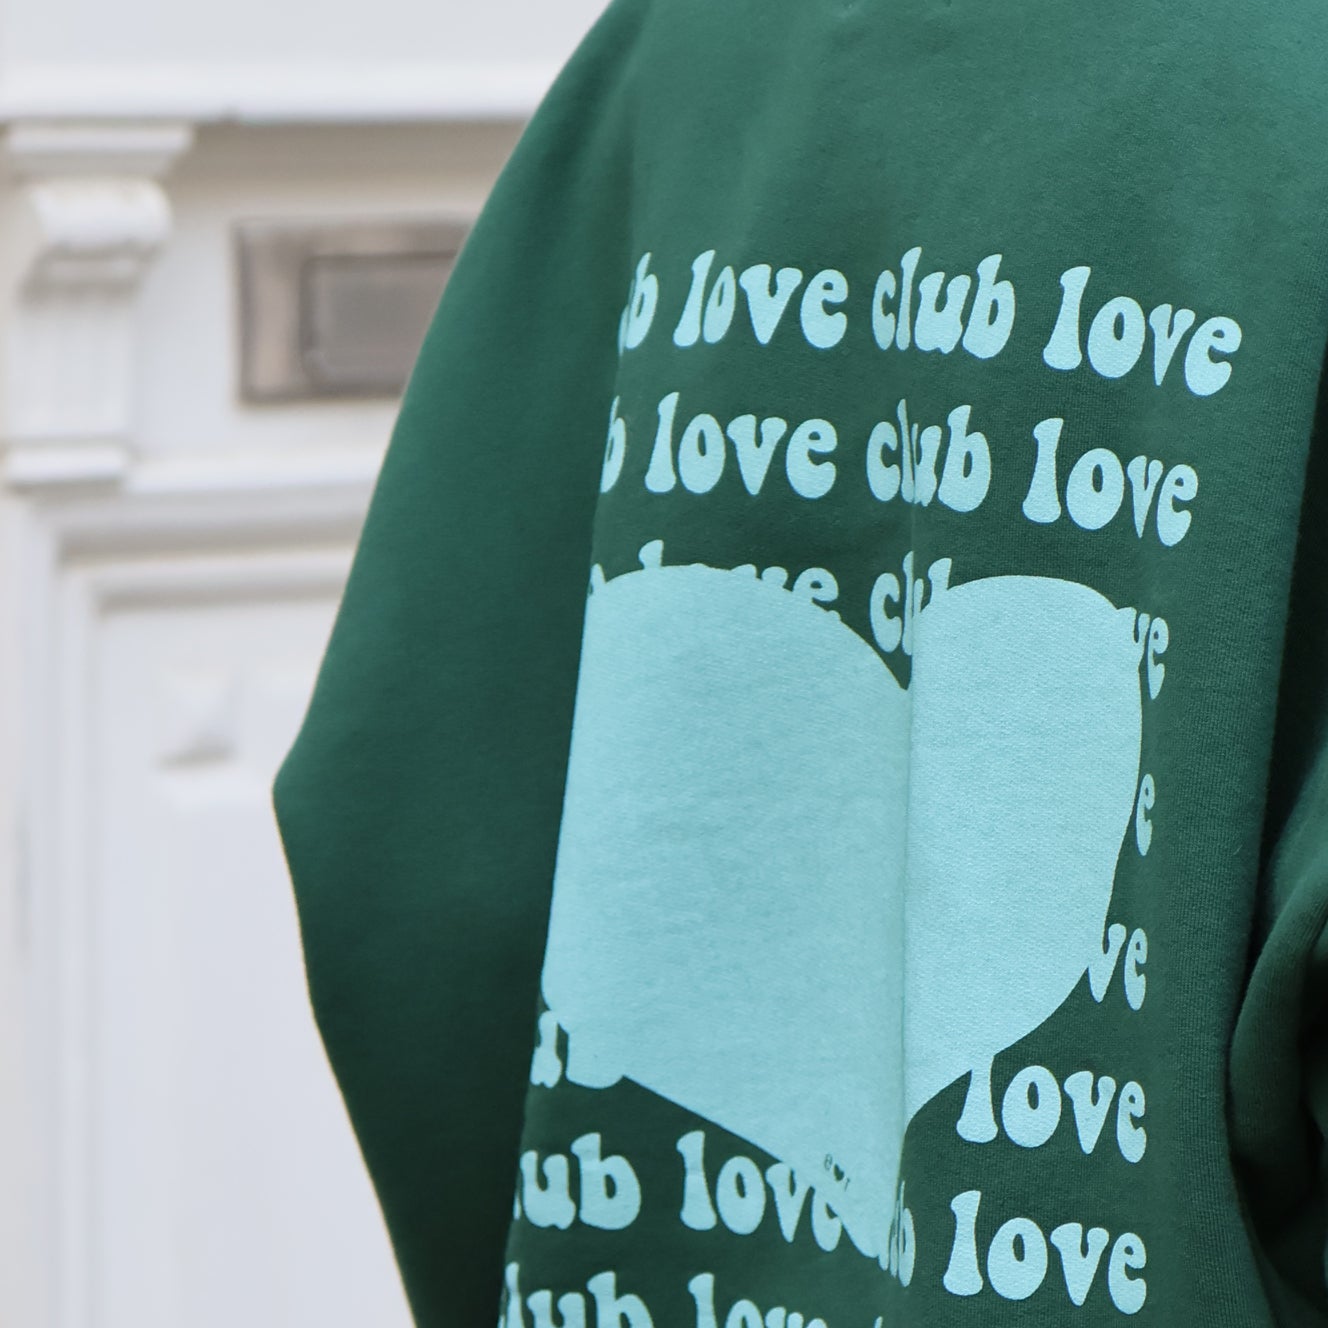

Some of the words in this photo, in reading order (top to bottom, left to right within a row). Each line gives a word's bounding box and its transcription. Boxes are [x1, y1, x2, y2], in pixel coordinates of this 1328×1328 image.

[672, 248, 849, 350] love
[871, 246, 1016, 360] club
[1042, 266, 1243, 397] love
[644, 391, 838, 499] love
[866, 398, 992, 513] club
[1022, 417, 1199, 547] love
[955, 1052, 1148, 1164] love
[942, 1189, 1148, 1315] love
